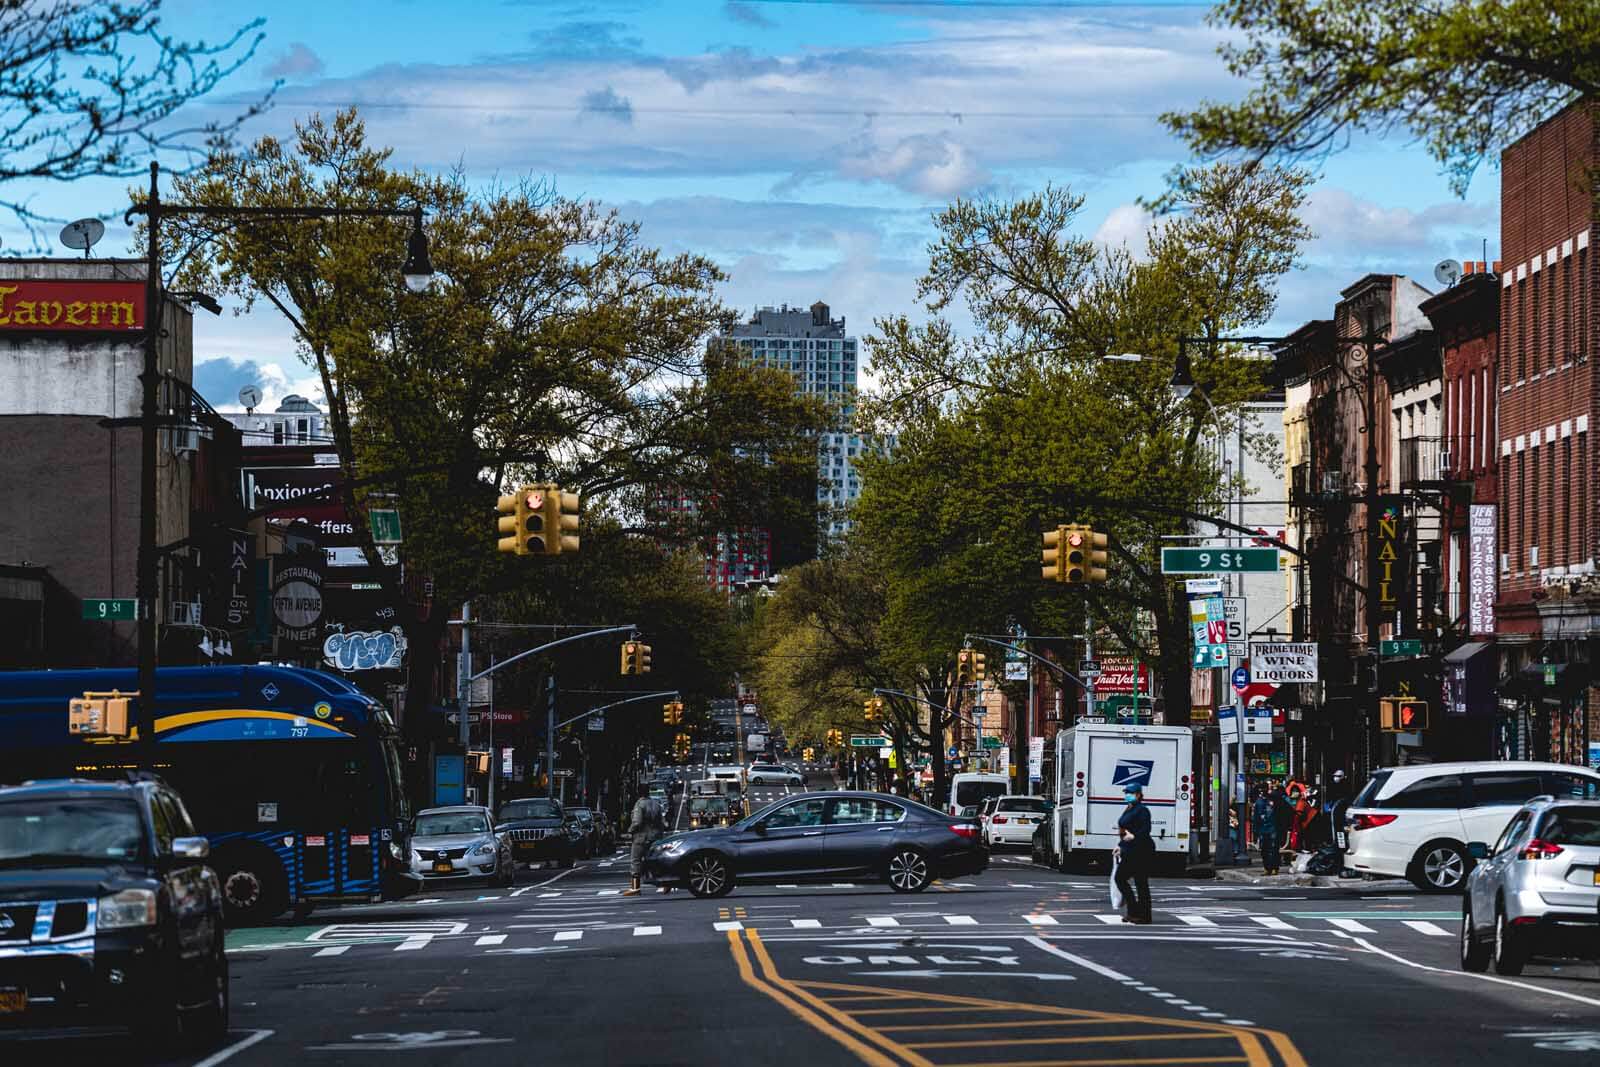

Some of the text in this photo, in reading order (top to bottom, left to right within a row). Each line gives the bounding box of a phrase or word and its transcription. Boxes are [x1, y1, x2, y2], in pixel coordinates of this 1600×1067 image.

[1200, 553, 1243, 567] 9 St
[99, 602, 106, 617] 9
[295, 598, 321, 611] AVENUE
[276, 625, 317, 641] DINER
[1229, 621, 1242, 638] 5
[1255, 645, 1314, 657] PRIMETIME
[1393, 642, 1399, 653] 9
[1264, 656, 1305, 665] WINE
[1094, 673, 1117, 685] True
[1255, 671, 1314, 681] LIQUORS
[481, 711, 492, 720] PS
[493, 711, 513, 720] Store
[290, 727, 308, 737] 797
[803, 955, 1020, 965] ONLY
